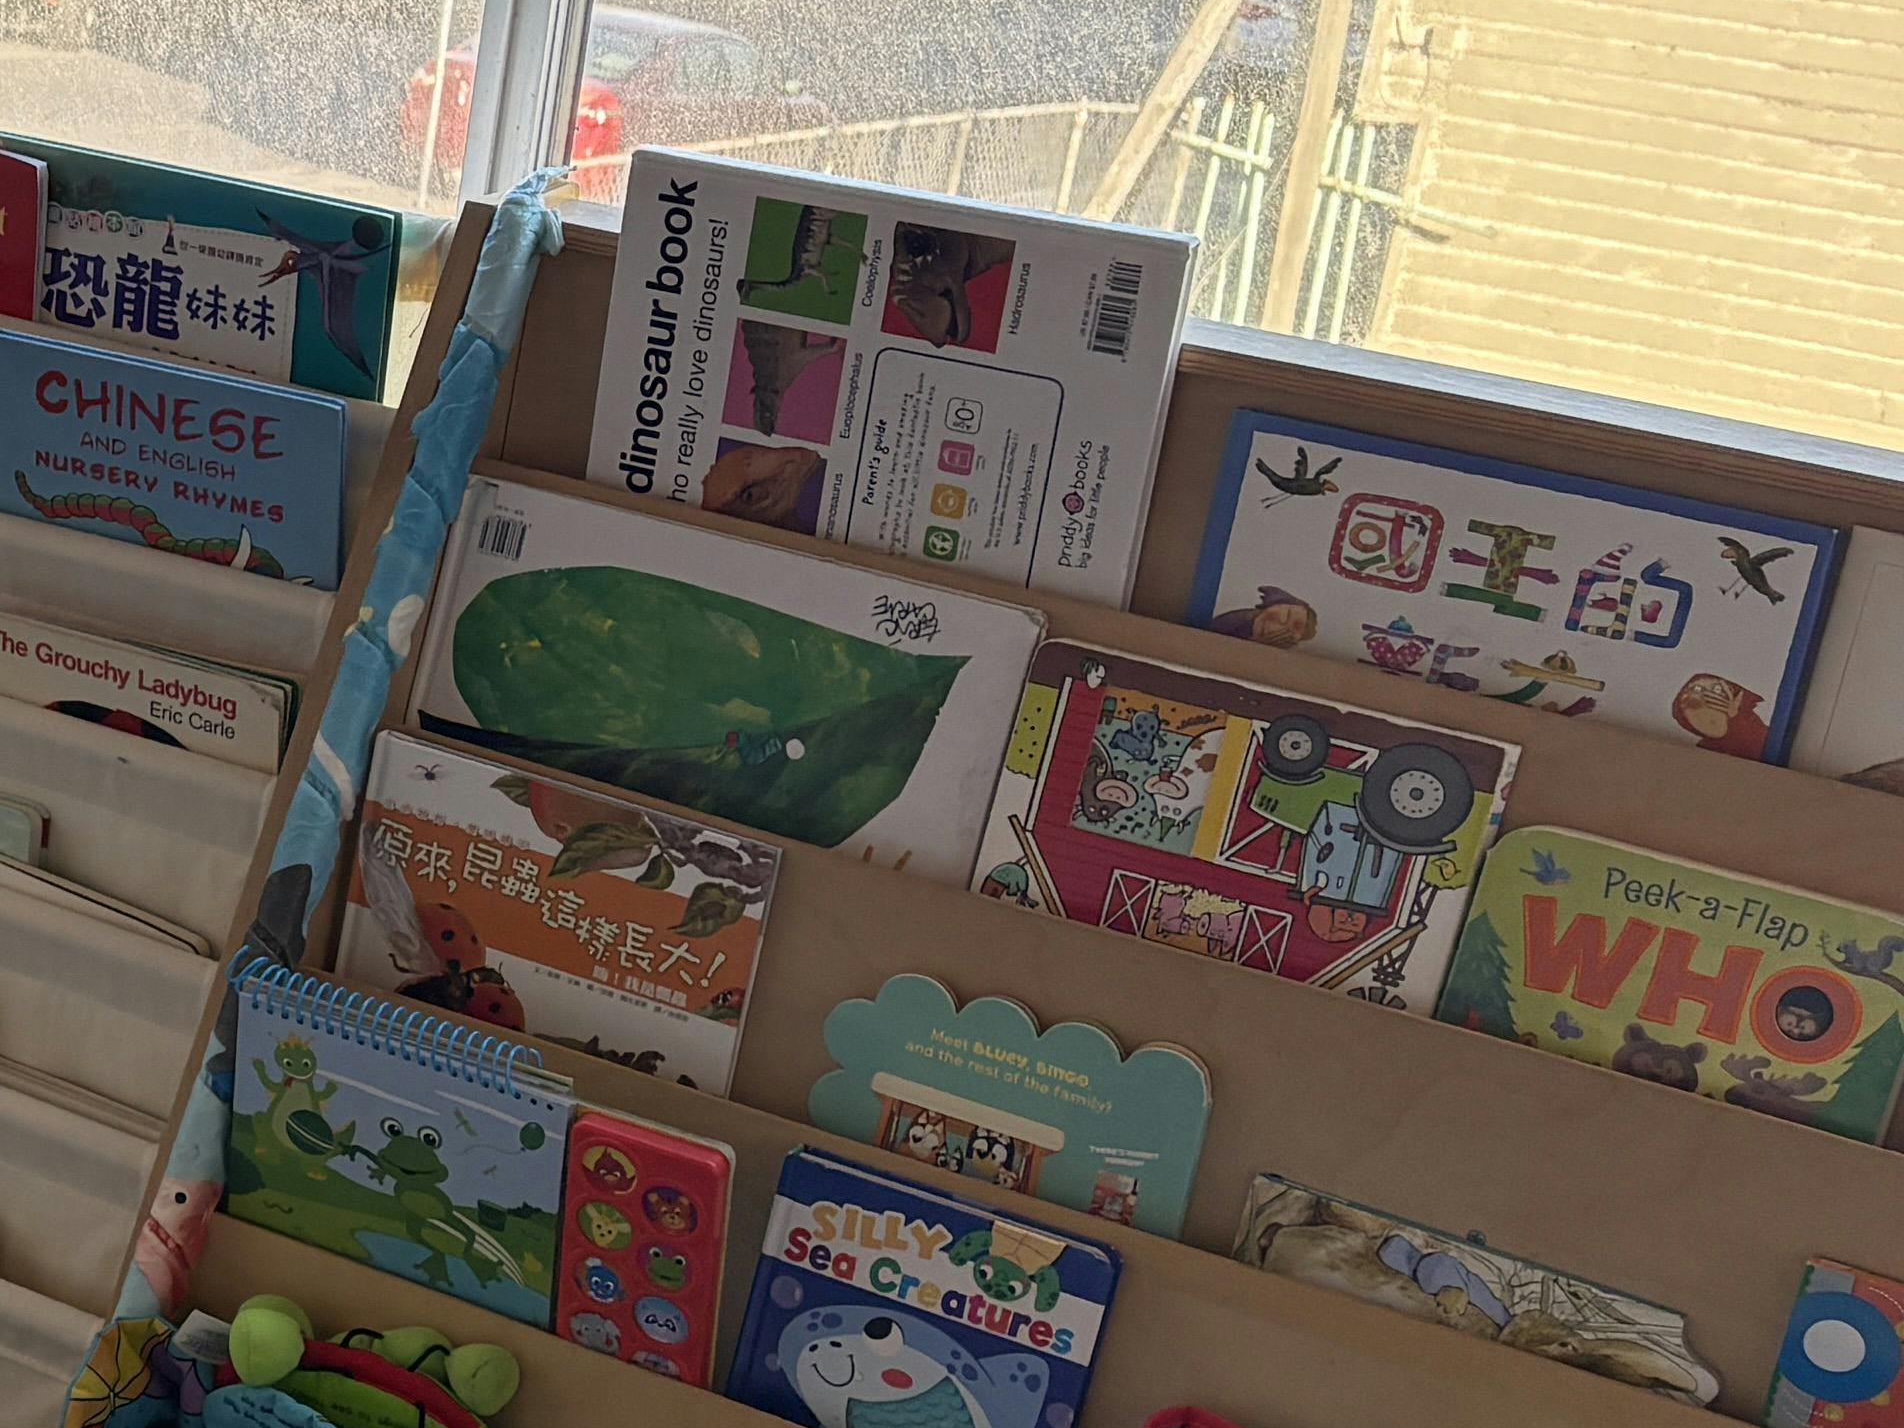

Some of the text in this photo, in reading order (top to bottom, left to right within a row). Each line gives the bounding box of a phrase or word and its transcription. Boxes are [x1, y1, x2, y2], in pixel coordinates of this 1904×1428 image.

[42, 245, 276, 343] 恐龍妹妹
[614, 175, 702, 496] dinosaur book
[666, 217, 732, 503] ho really love dinosaurs!
[35, 370, 284, 461] CHINESE
[35, 450, 285, 524] NURSERY RHYMES
[79, 431, 236, 481] AND ENGLISH
[862, 418, 894, 505] Parent's guide
[1069, 439, 1093, 491] books
[1095, 444, 1111, 480] people
[1080, 521, 1096, 550] ideas
[1085, 504, 1099, 520] for
[1077, 552, 1092, 570] big
[34, 642, 131, 691] Grouchy
[137, 668, 238, 721] Ladybug
[149, 699, 236, 741] Eric Carle
[1604, 867, 1810, 952] Peek-a-Flap
[1523, 894, 1864, 1065] WHO
[904, 1040, 935, 1059] and
[938, 1050, 965, 1066] the
[967, 1059, 1000, 1079] rest
[1002, 1071, 1020, 1085] of
[1023, 1075, 1051, 1095] the
[810, 1201, 954, 1262] SILLY
[784, 1227, 1075, 1356] Sea Creatures
